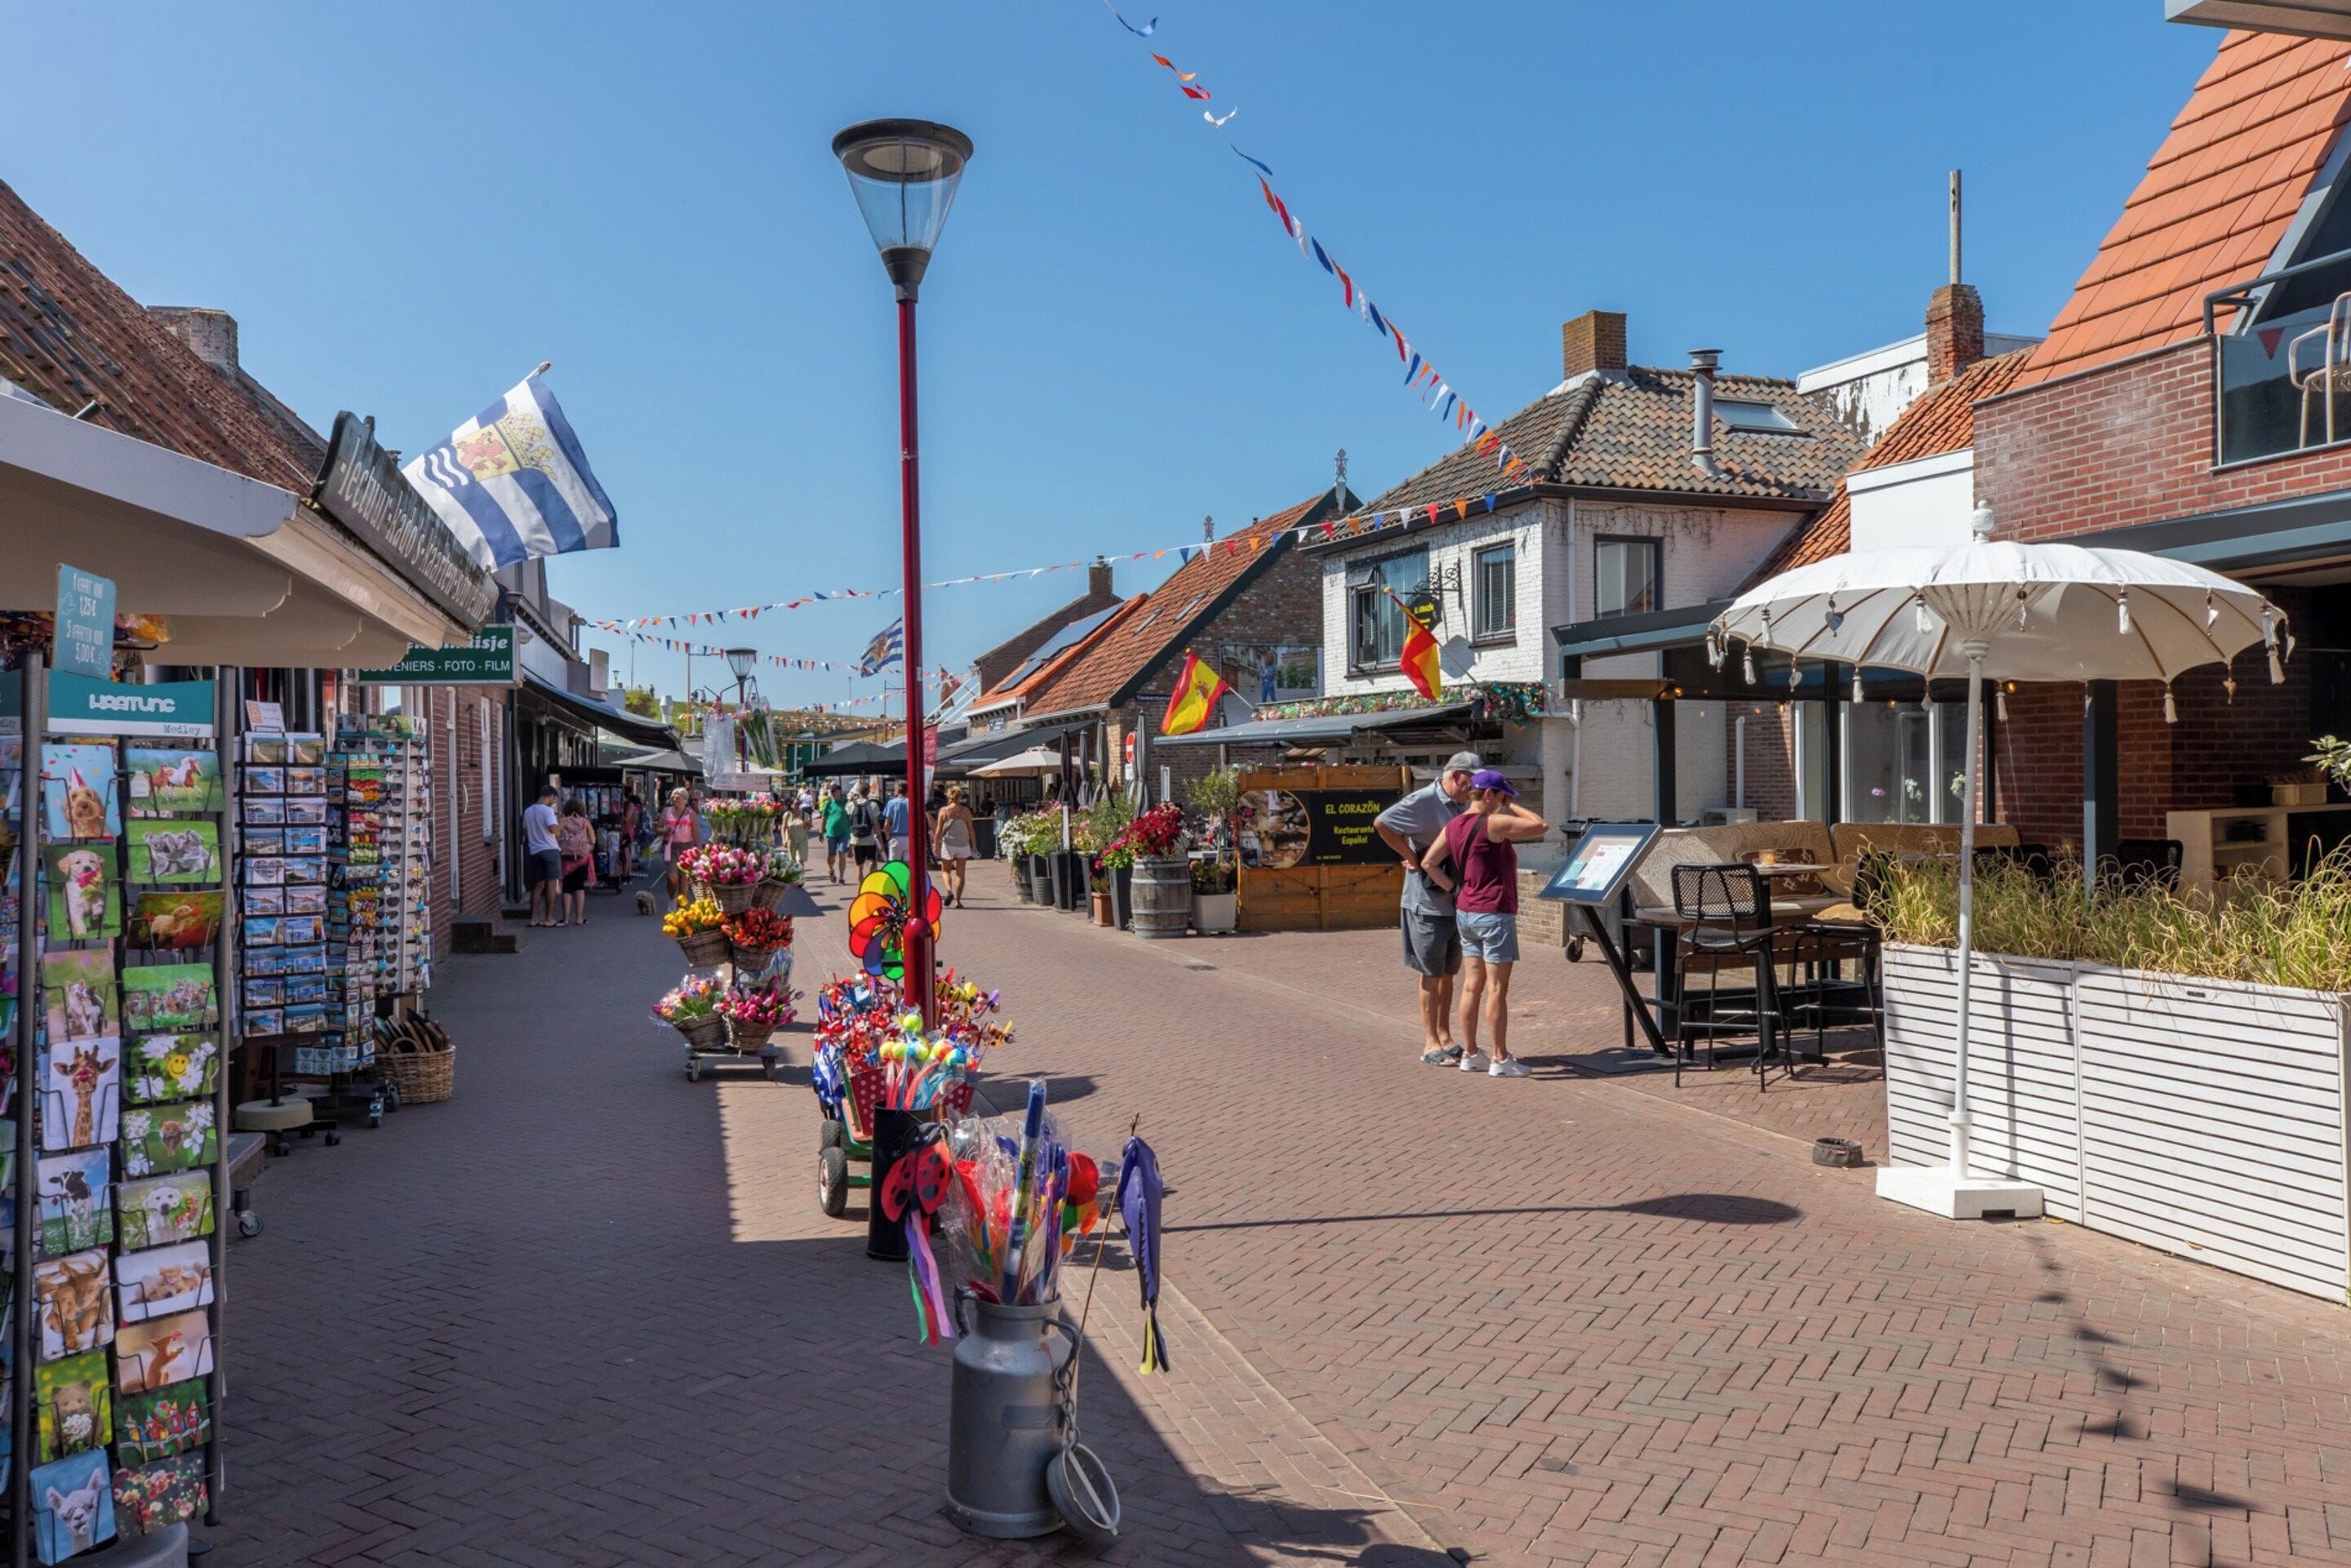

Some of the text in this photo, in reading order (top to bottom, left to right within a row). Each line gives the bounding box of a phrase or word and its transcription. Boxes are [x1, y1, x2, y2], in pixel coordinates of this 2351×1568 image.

[66, 620, 72, 638] 5
[444, 660, 476, 672] FOTO
[485, 660, 510, 671] FILM
[163, 724, 202, 735] Medley
[1326, 804, 1336, 815] EL
[1341, 835, 1368, 846] Español
